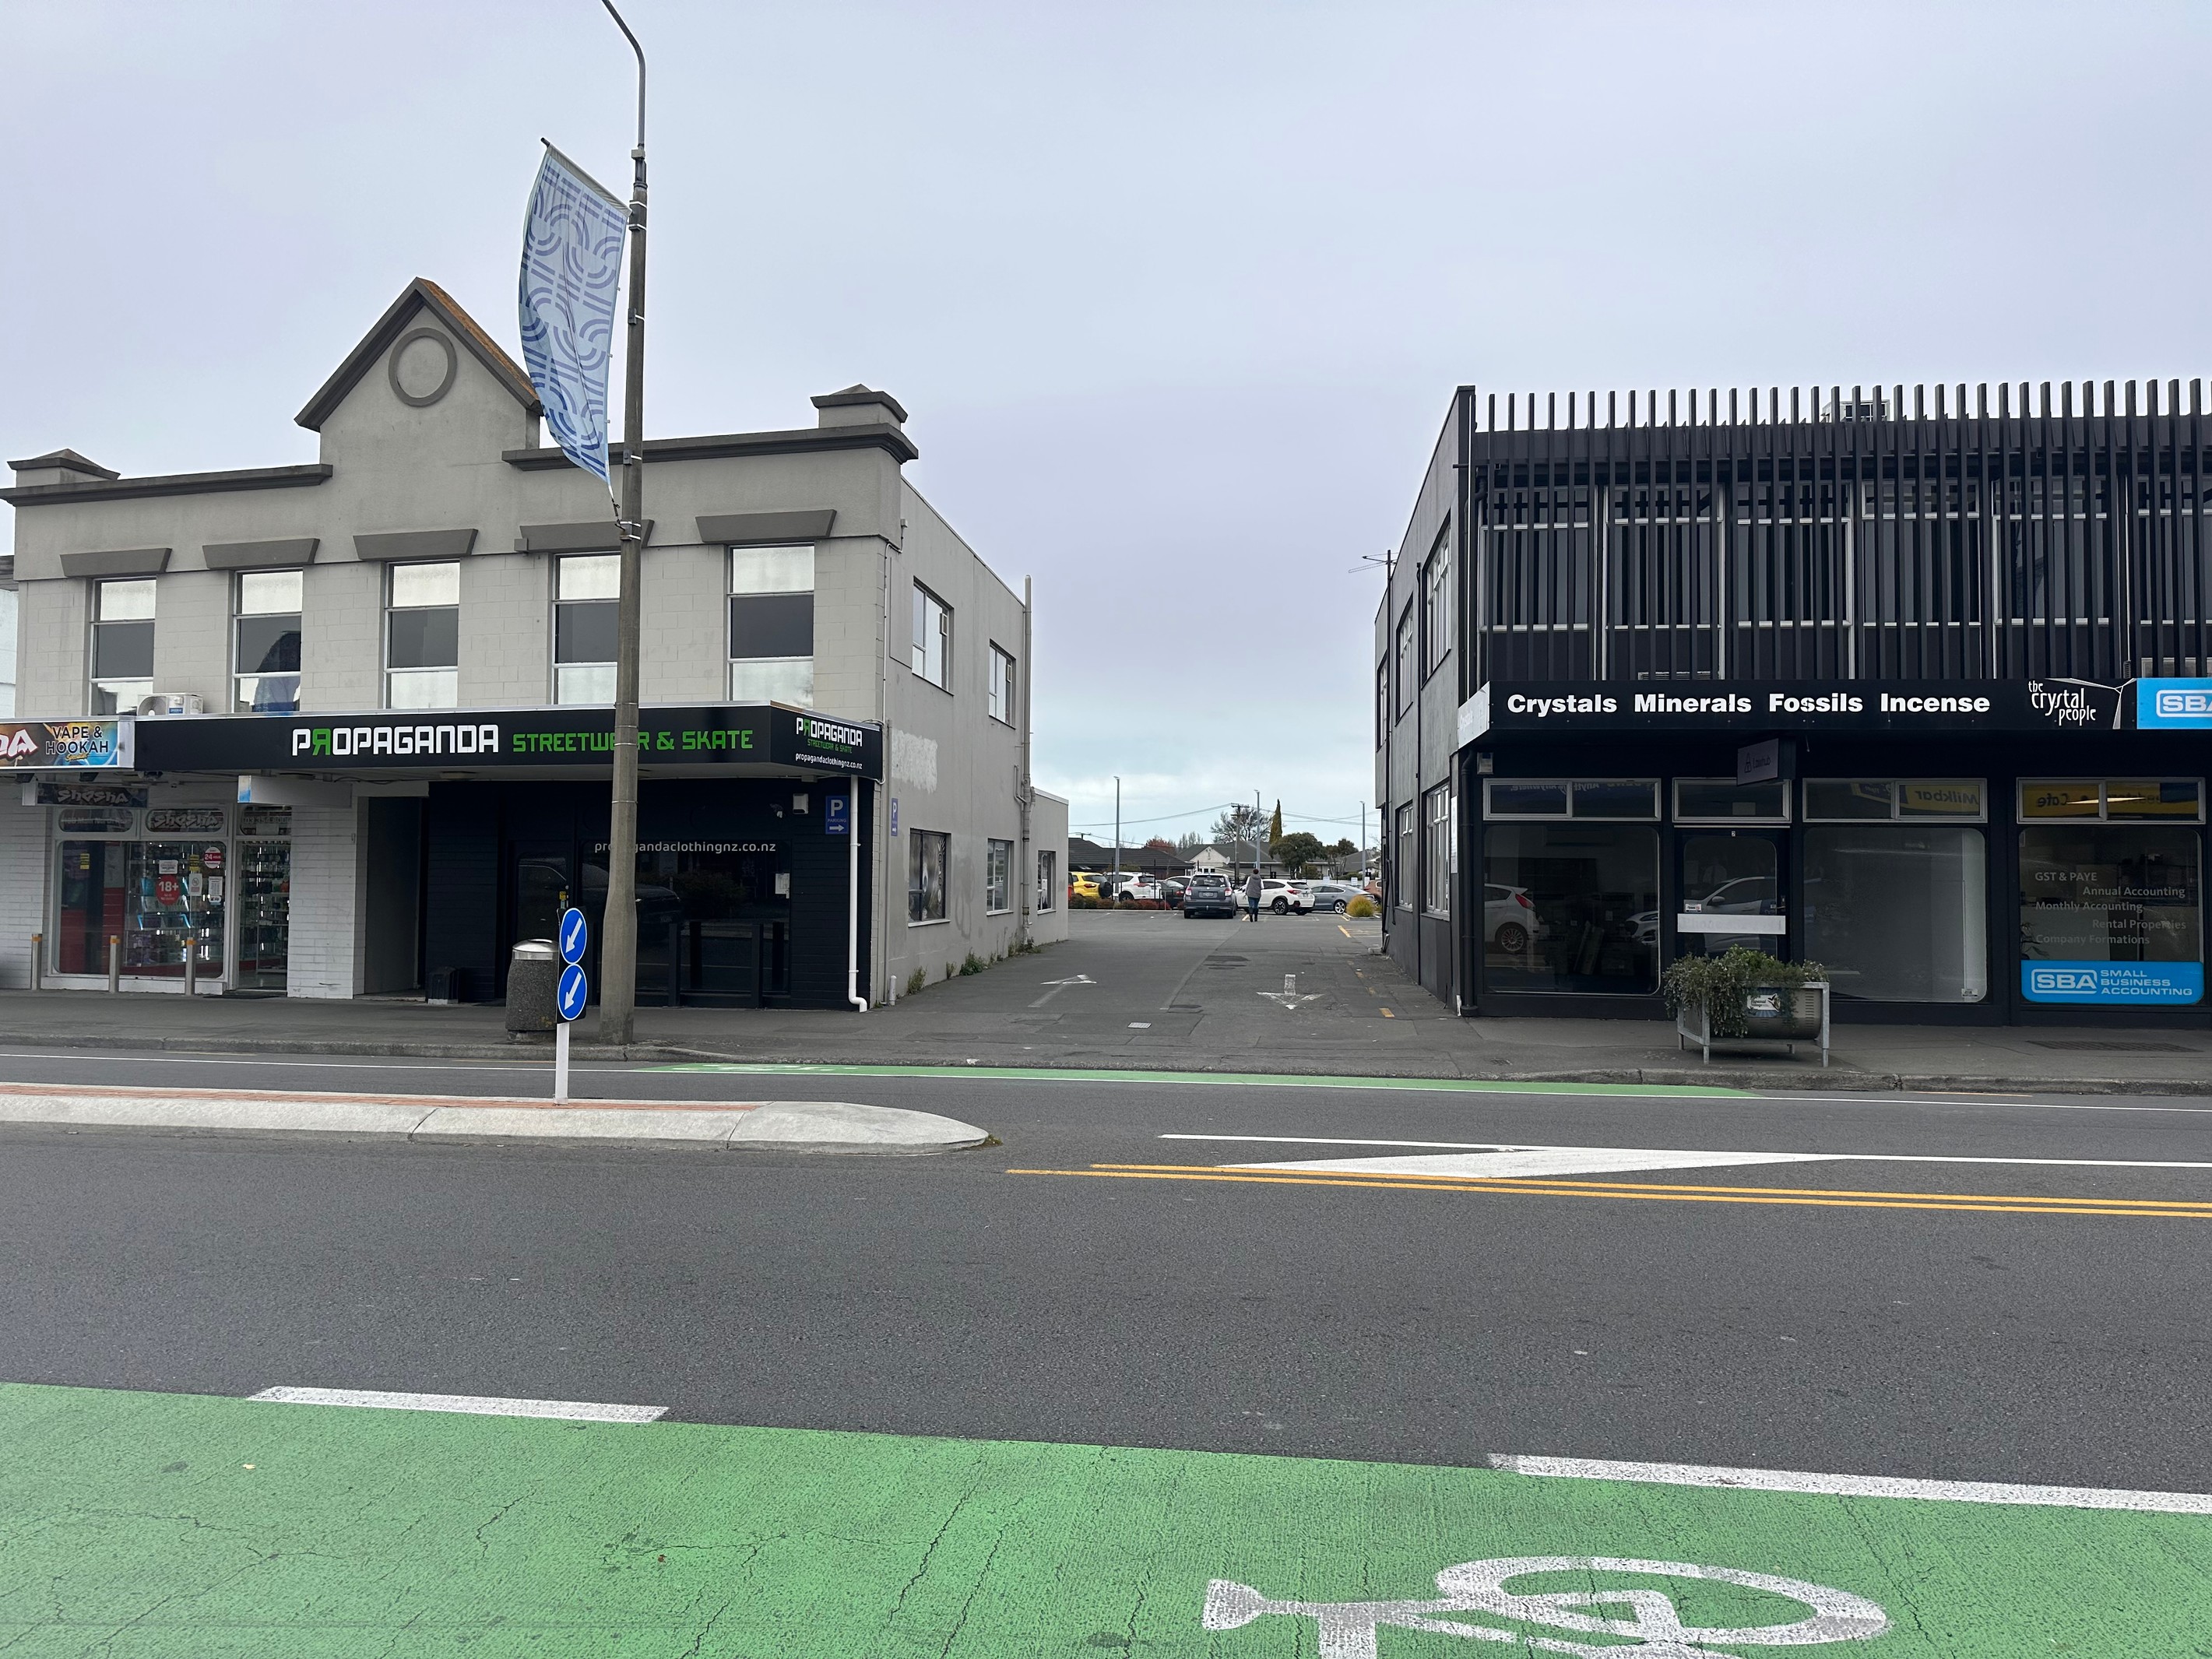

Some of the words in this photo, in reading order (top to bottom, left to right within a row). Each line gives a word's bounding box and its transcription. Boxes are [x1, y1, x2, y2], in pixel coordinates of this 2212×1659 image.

[2028, 680, 2043, 693] the
[1507, 694, 1617, 717] Crystals
[1634, 694, 1751, 712] Minerals
[1769, 693, 1863, 712] Fossils
[1880, 693, 1990, 712] Incense
[2059, 705, 2096, 726] people
[51, 726, 89, 739] VAPE
[93, 726, 103, 739] &
[796, 717, 863, 747] PROPAGANDA
[292, 724, 499, 756] PROPAGANDA
[513, 732, 650, 752] STREETWR
[656, 732, 674, 750] &
[682, 729, 753, 750] SKATE
[45, 740, 109, 755] HOOKAH
[795, 753, 863, 770] propagandaclothingnz.co.nz
[831, 799, 843, 817] P
[595, 842, 776, 854] prandaclothingnz.co.nz
[2034, 872, 2056, 881] GST
[2059, 872, 2067, 881] &
[2070, 872, 2098, 881] PAYE
[158, 880, 179, 892] 18+
[2083, 886, 2120, 896] Annual
[2123, 886, 2186, 898] Accounting
[2035, 901, 2080, 913] Monthly
[2083, 902, 2143, 913] Accounting
[2093, 919, 2126, 929] Rental
[2129, 919, 2186, 933] Properties
[2036, 934, 2086, 947] Company
[2089, 934, 2150, 945] Formations
[2036, 974, 2097, 989] SBA
